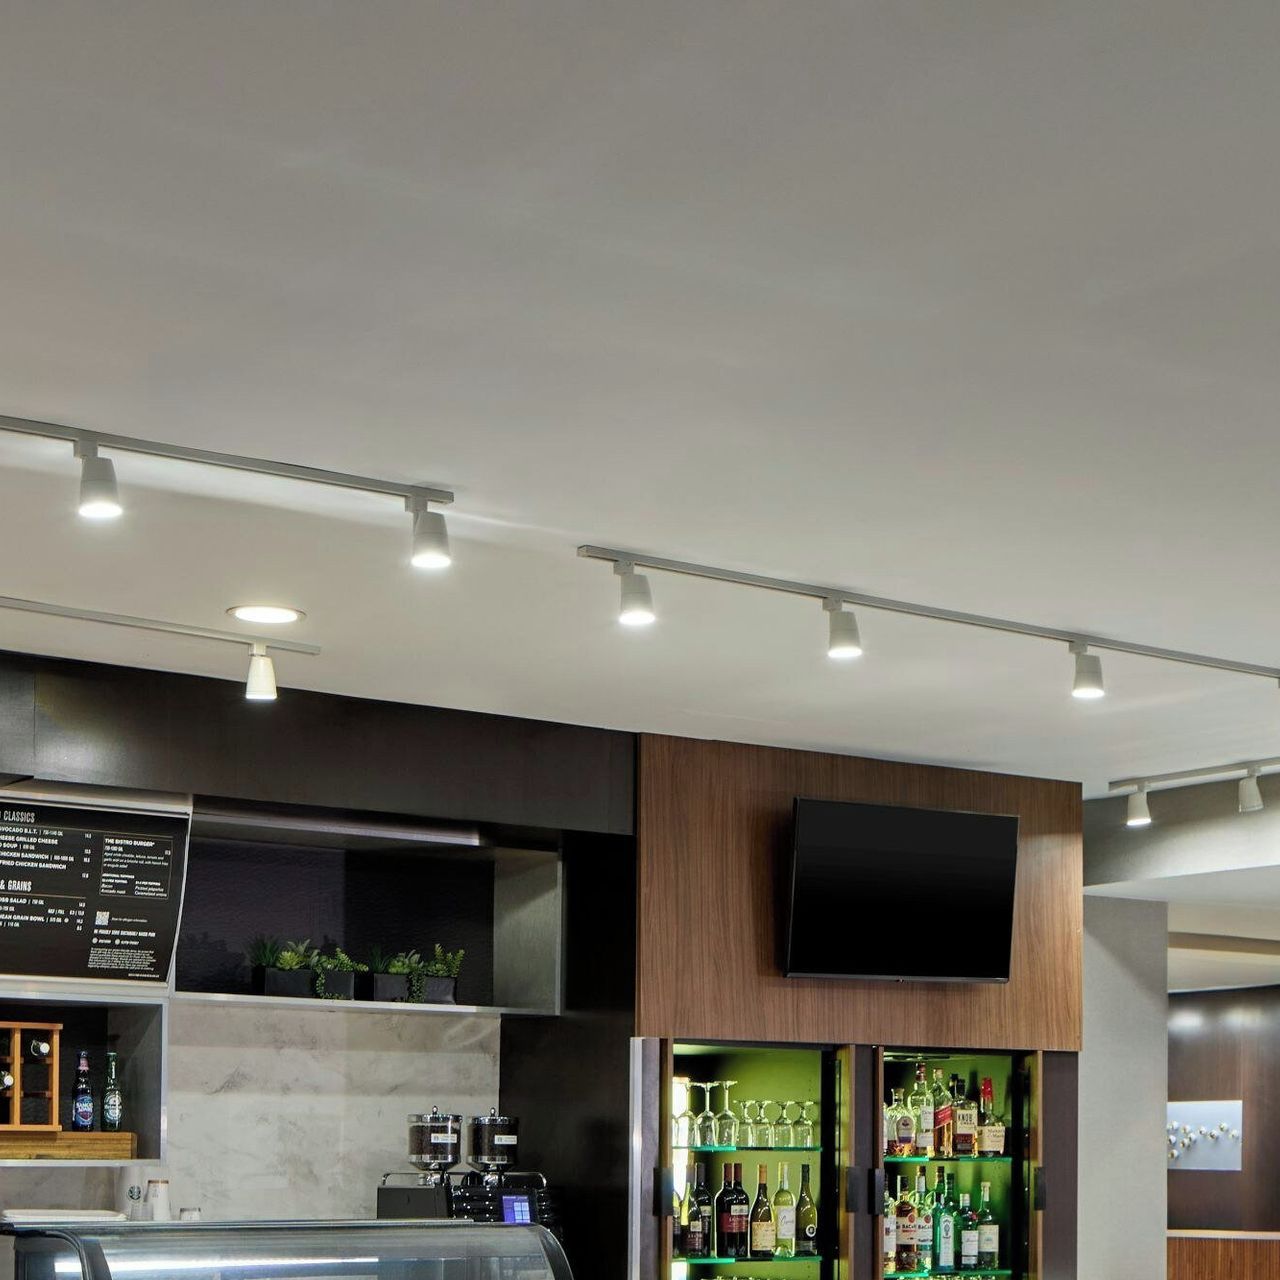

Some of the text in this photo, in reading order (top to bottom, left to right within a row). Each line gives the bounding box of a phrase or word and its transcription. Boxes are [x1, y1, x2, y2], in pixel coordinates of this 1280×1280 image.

[3, 810, 36, 824] CLASSICS
[0, 879, 6, 890] &
[7, 879, 32, 892] GRAINS
